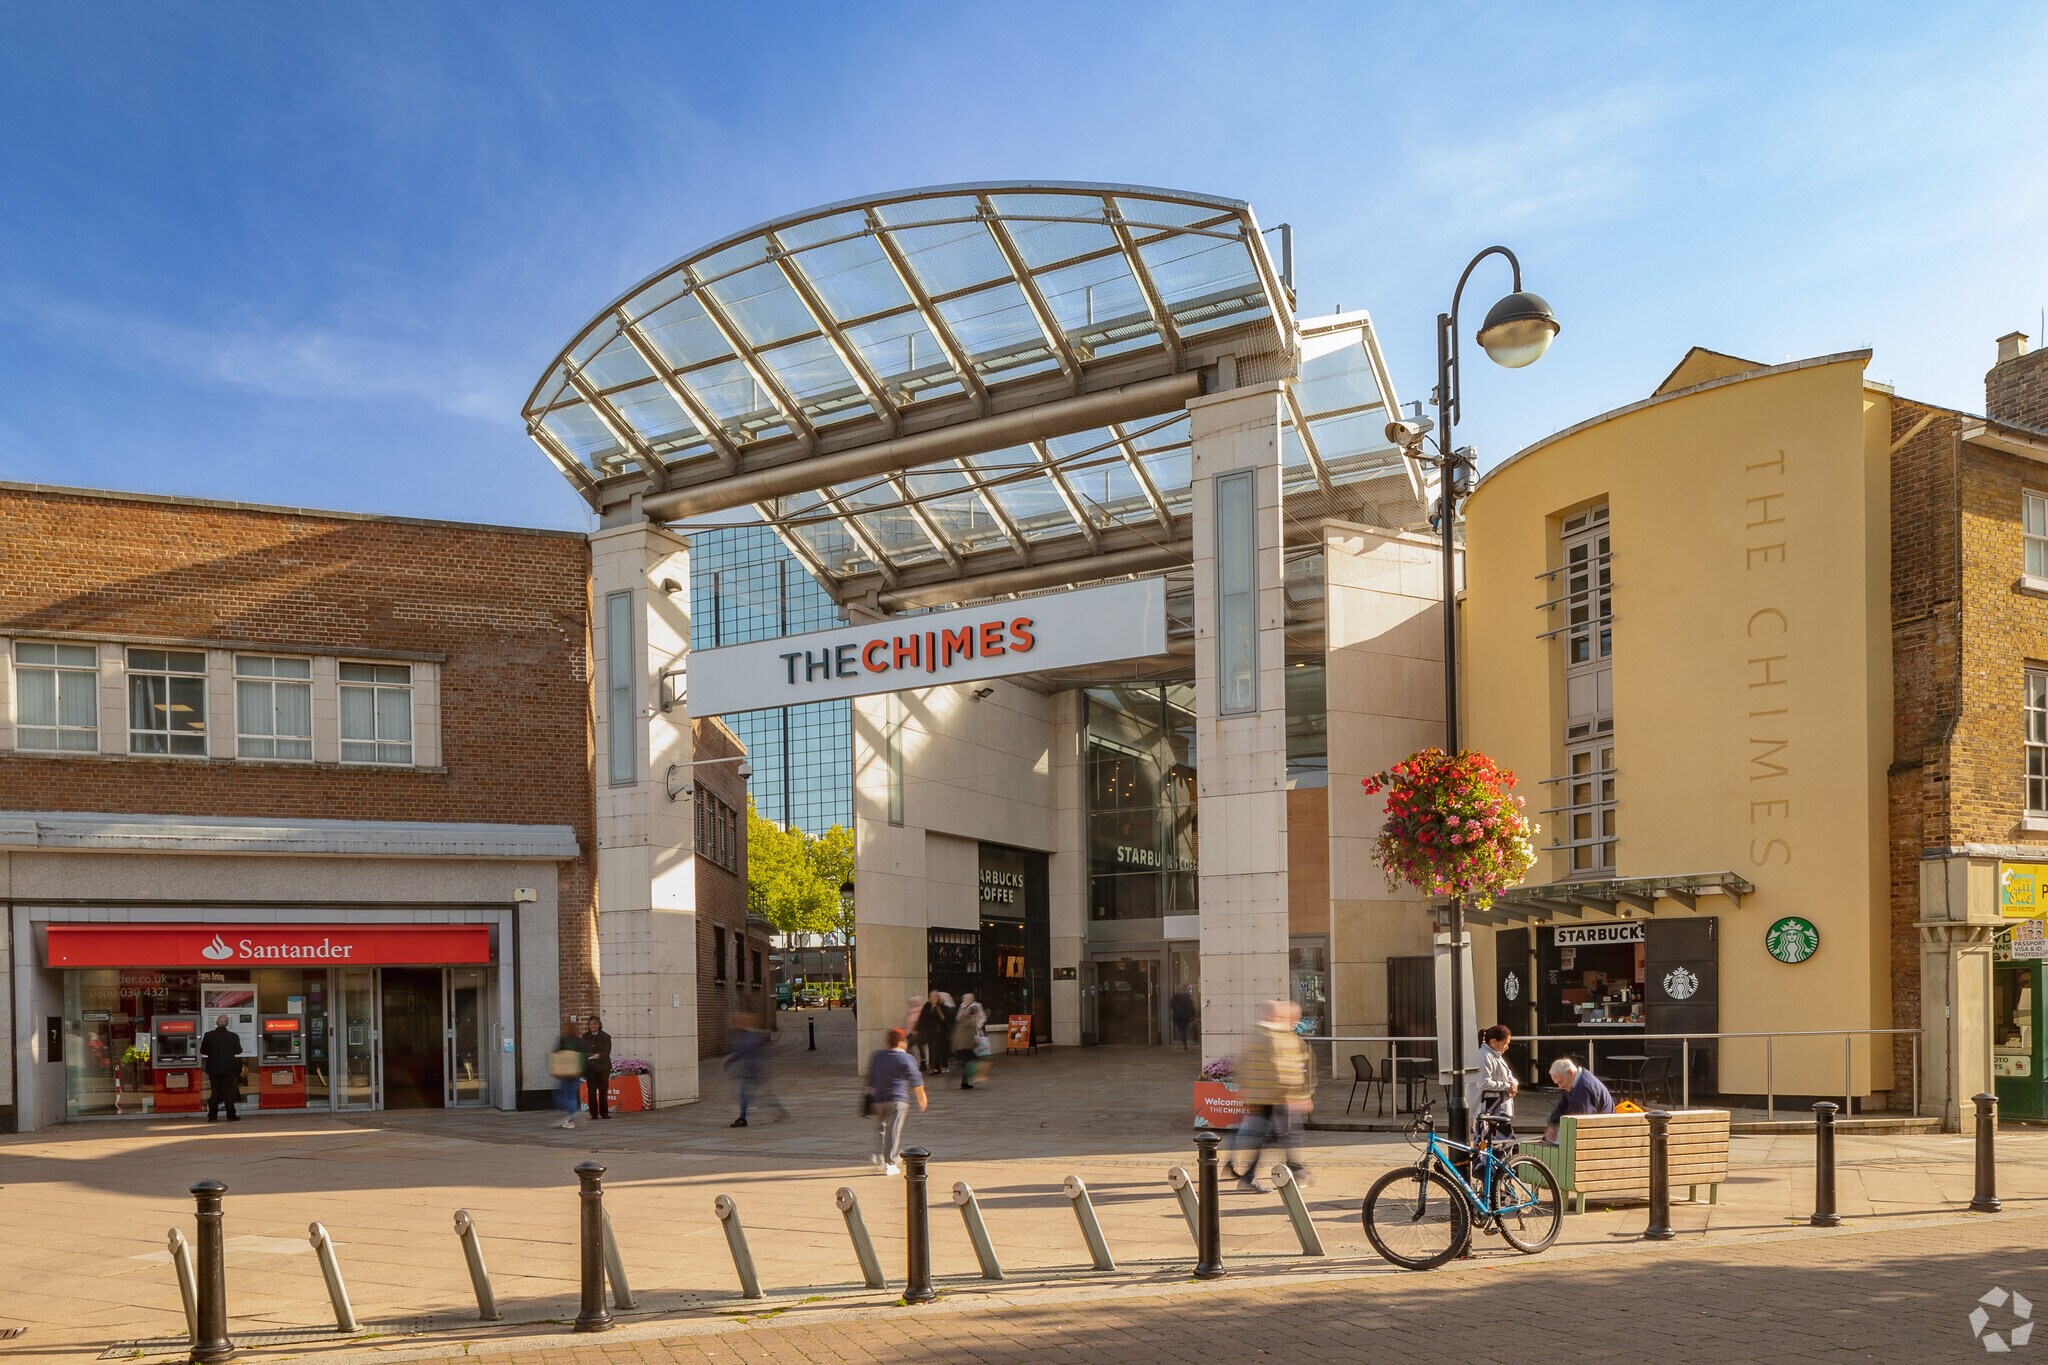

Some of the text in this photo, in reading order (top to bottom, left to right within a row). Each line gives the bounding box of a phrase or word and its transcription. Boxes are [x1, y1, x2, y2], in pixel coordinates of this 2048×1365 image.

[1745, 448, 1791, 867] THE CHIMES
[979, 869, 1024, 888] ARBUCKS
[239, 937, 353, 959] Santander
[89, 986, 169, 999] 0800 030 4321
[1204, 1097, 1244, 1107] Welcome
